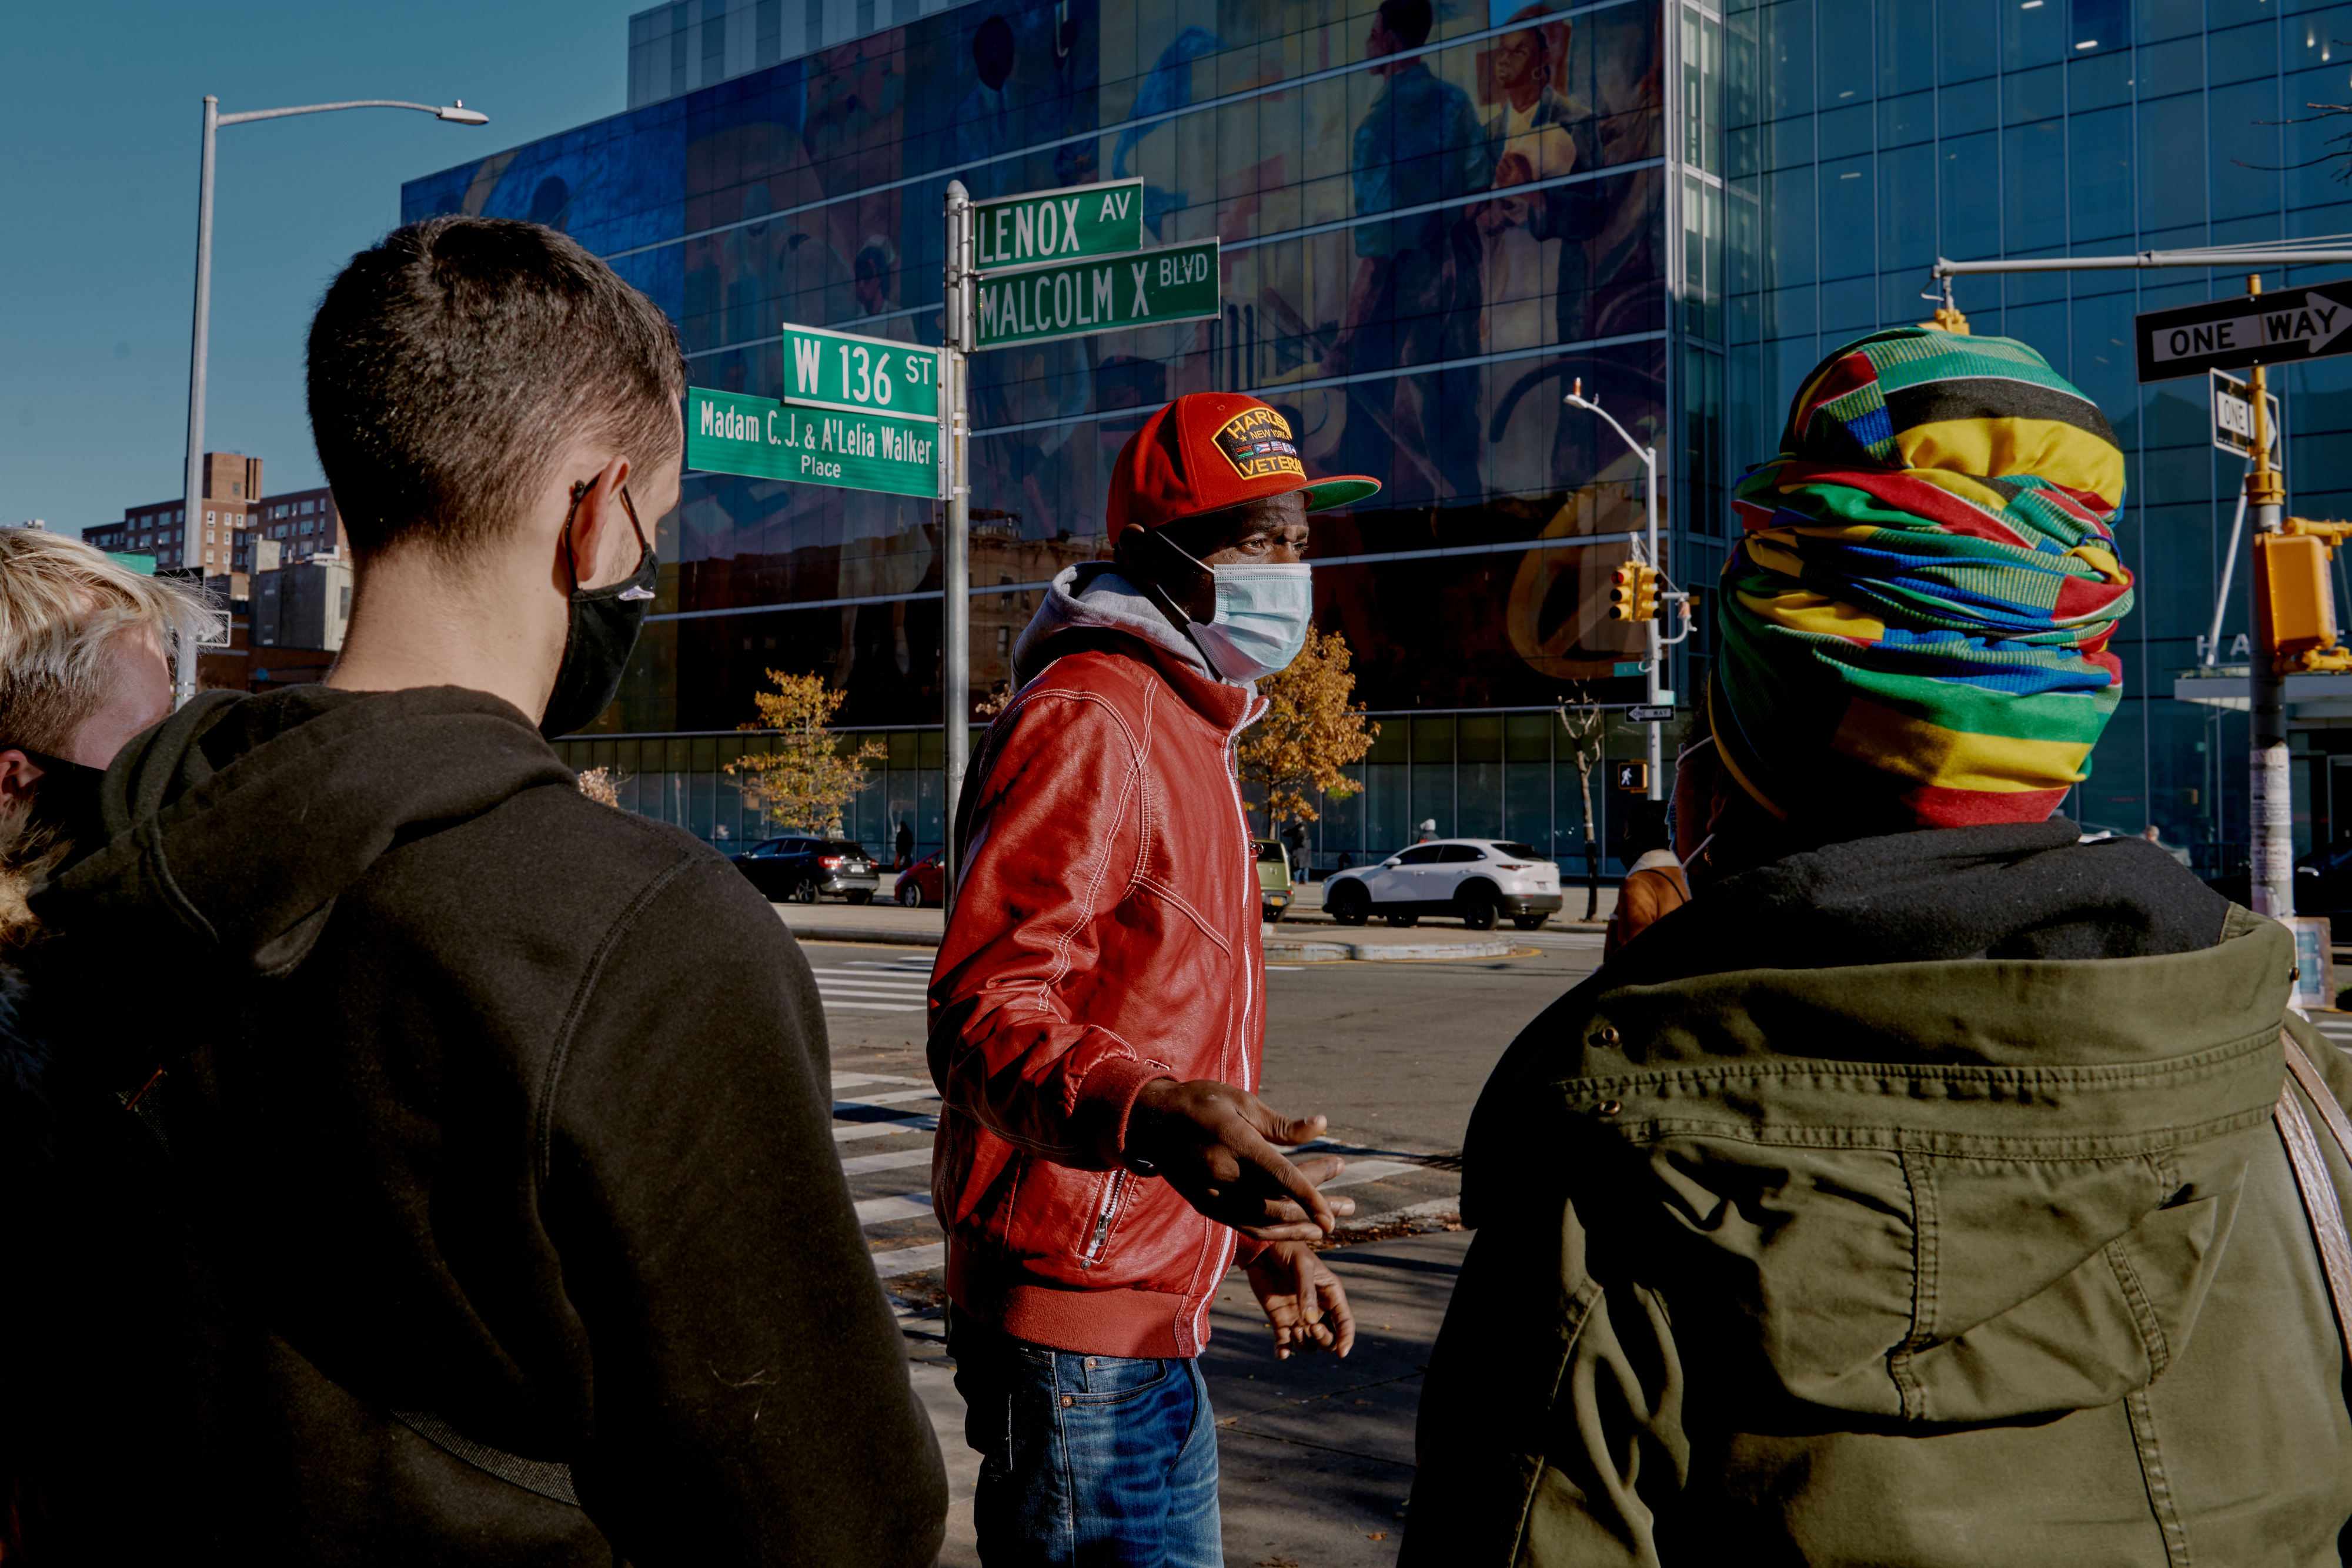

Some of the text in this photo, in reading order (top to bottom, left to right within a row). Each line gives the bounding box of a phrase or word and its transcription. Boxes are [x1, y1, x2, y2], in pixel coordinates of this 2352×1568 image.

[979, 191, 1131, 264] LENOX AV
[980, 252, 1208, 339] MALCOLM X BLVD
[2170, 305, 2338, 356] ONE WAY
[793, 336, 933, 406] W 136 ST
[701, 400, 759, 443] Madam
[804, 423, 816, 450] &
[821, 417, 875, 457] A'Lelia
[881, 426, 932, 464] Walker
[1250, 429, 1287, 440] NEW YORK
[2224, 399, 2244, 431] ONE
[801, 454, 841, 479] Place
